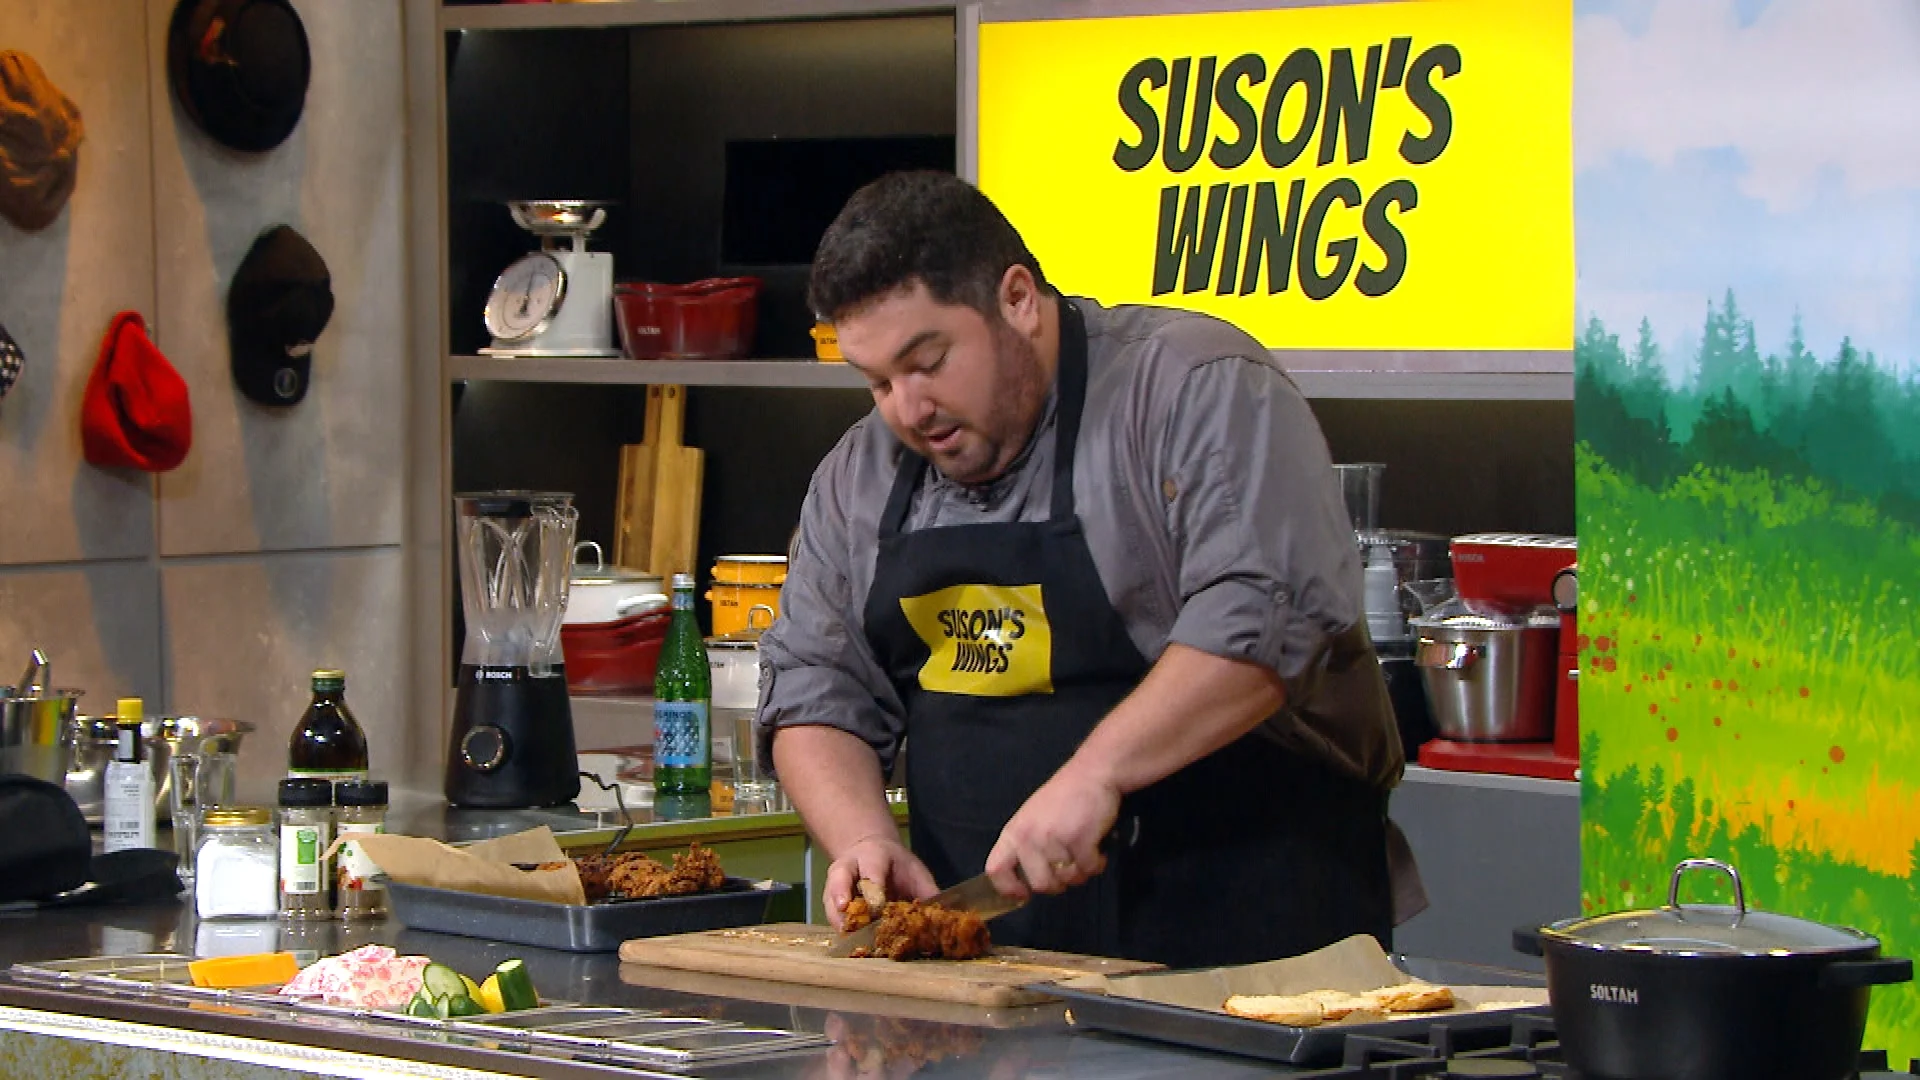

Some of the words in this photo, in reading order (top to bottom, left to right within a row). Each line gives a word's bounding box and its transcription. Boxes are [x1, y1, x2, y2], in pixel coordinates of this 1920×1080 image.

[1112, 36, 1462, 173] SUSON'S
[1151, 177, 1419, 301] WINGS
[937, 607, 1025, 640] SUSON'S
[950, 641, 1013, 674] WINGS
[1589, 983, 1639, 1005] SOLTAM
